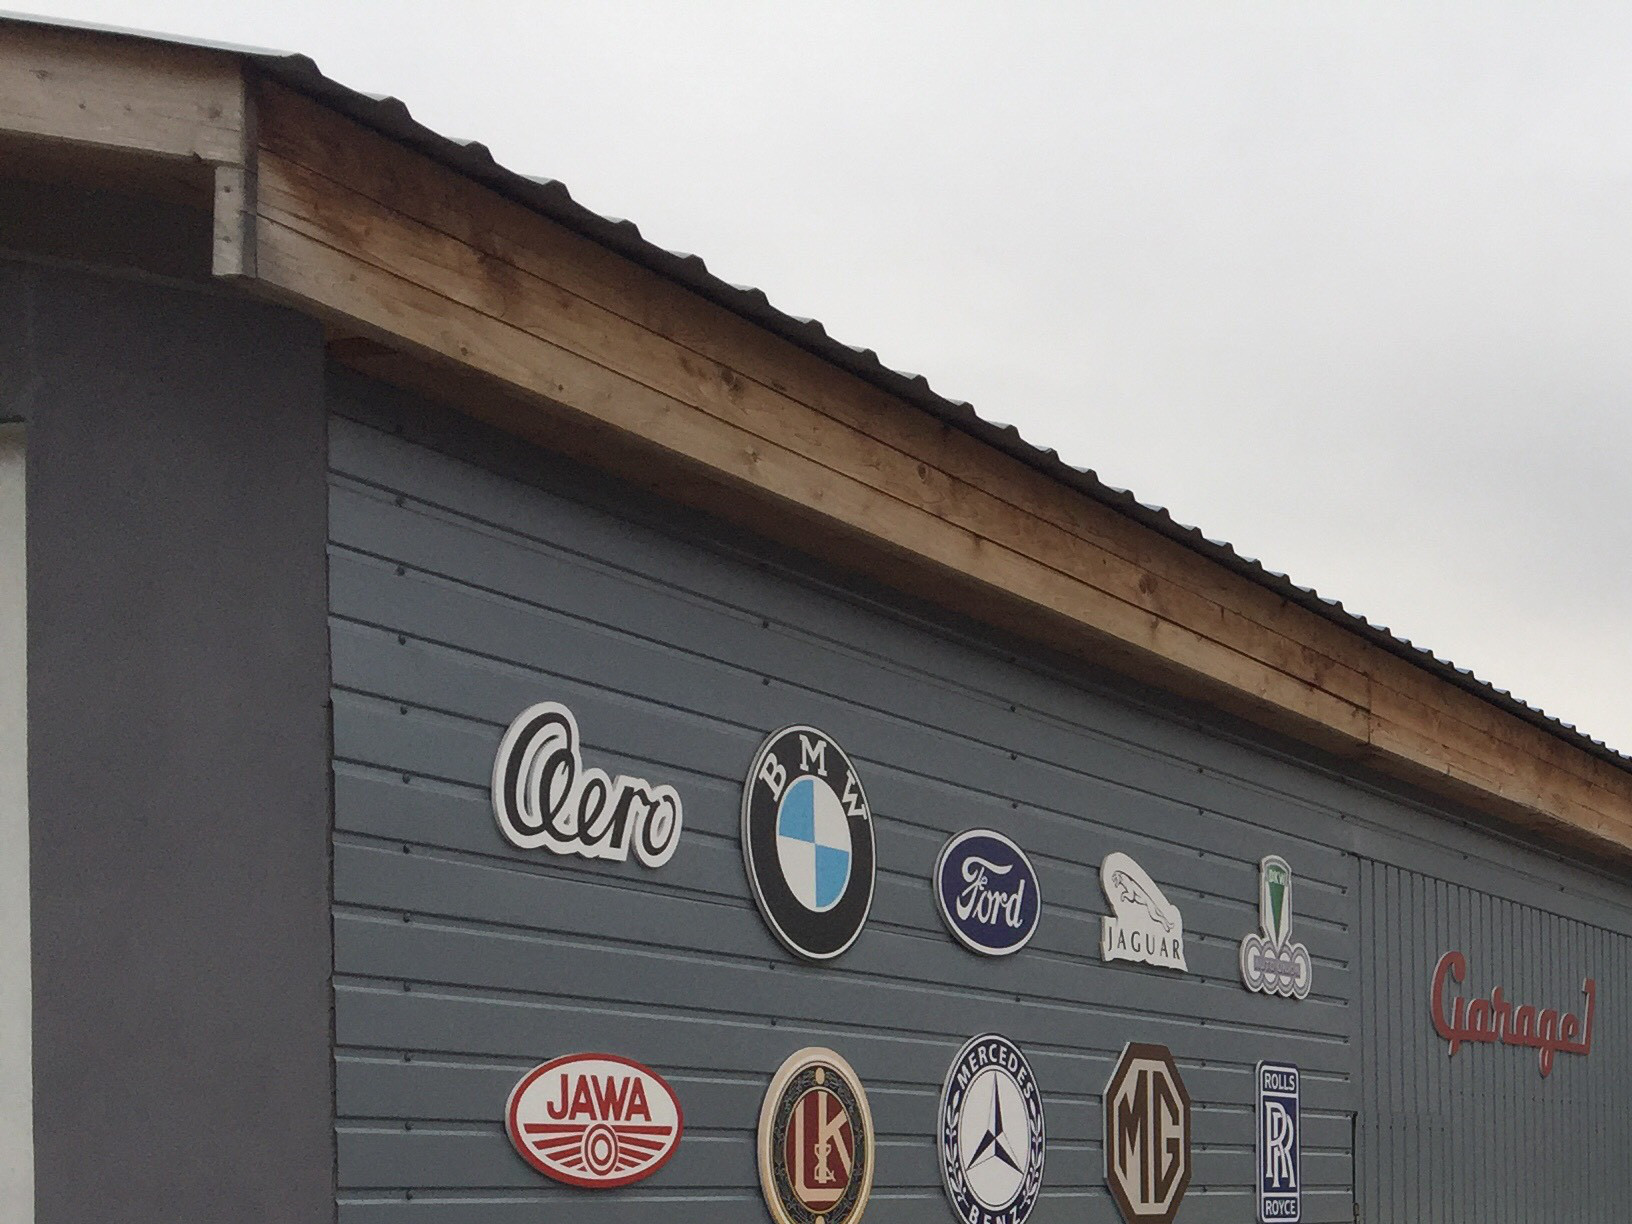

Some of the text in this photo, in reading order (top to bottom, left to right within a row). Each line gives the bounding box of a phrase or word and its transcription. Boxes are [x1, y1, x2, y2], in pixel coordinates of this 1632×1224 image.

[504, 711, 677, 858] Aero
[759, 734, 870, 822] BMW
[955, 855, 1027, 930] Ford
[1107, 925, 1181, 960] JAGUAR
[546, 1073, 652, 1122] JAWA
[957, 1042, 1034, 1099] MERCEDES
[1263, 1072, 1296, 1092] ROLLS
[1117, 1069, 1182, 1204] MG
[1264, 1101, 1296, 1188] RR
[1264, 1200, 1297, 1217] ROYCE
